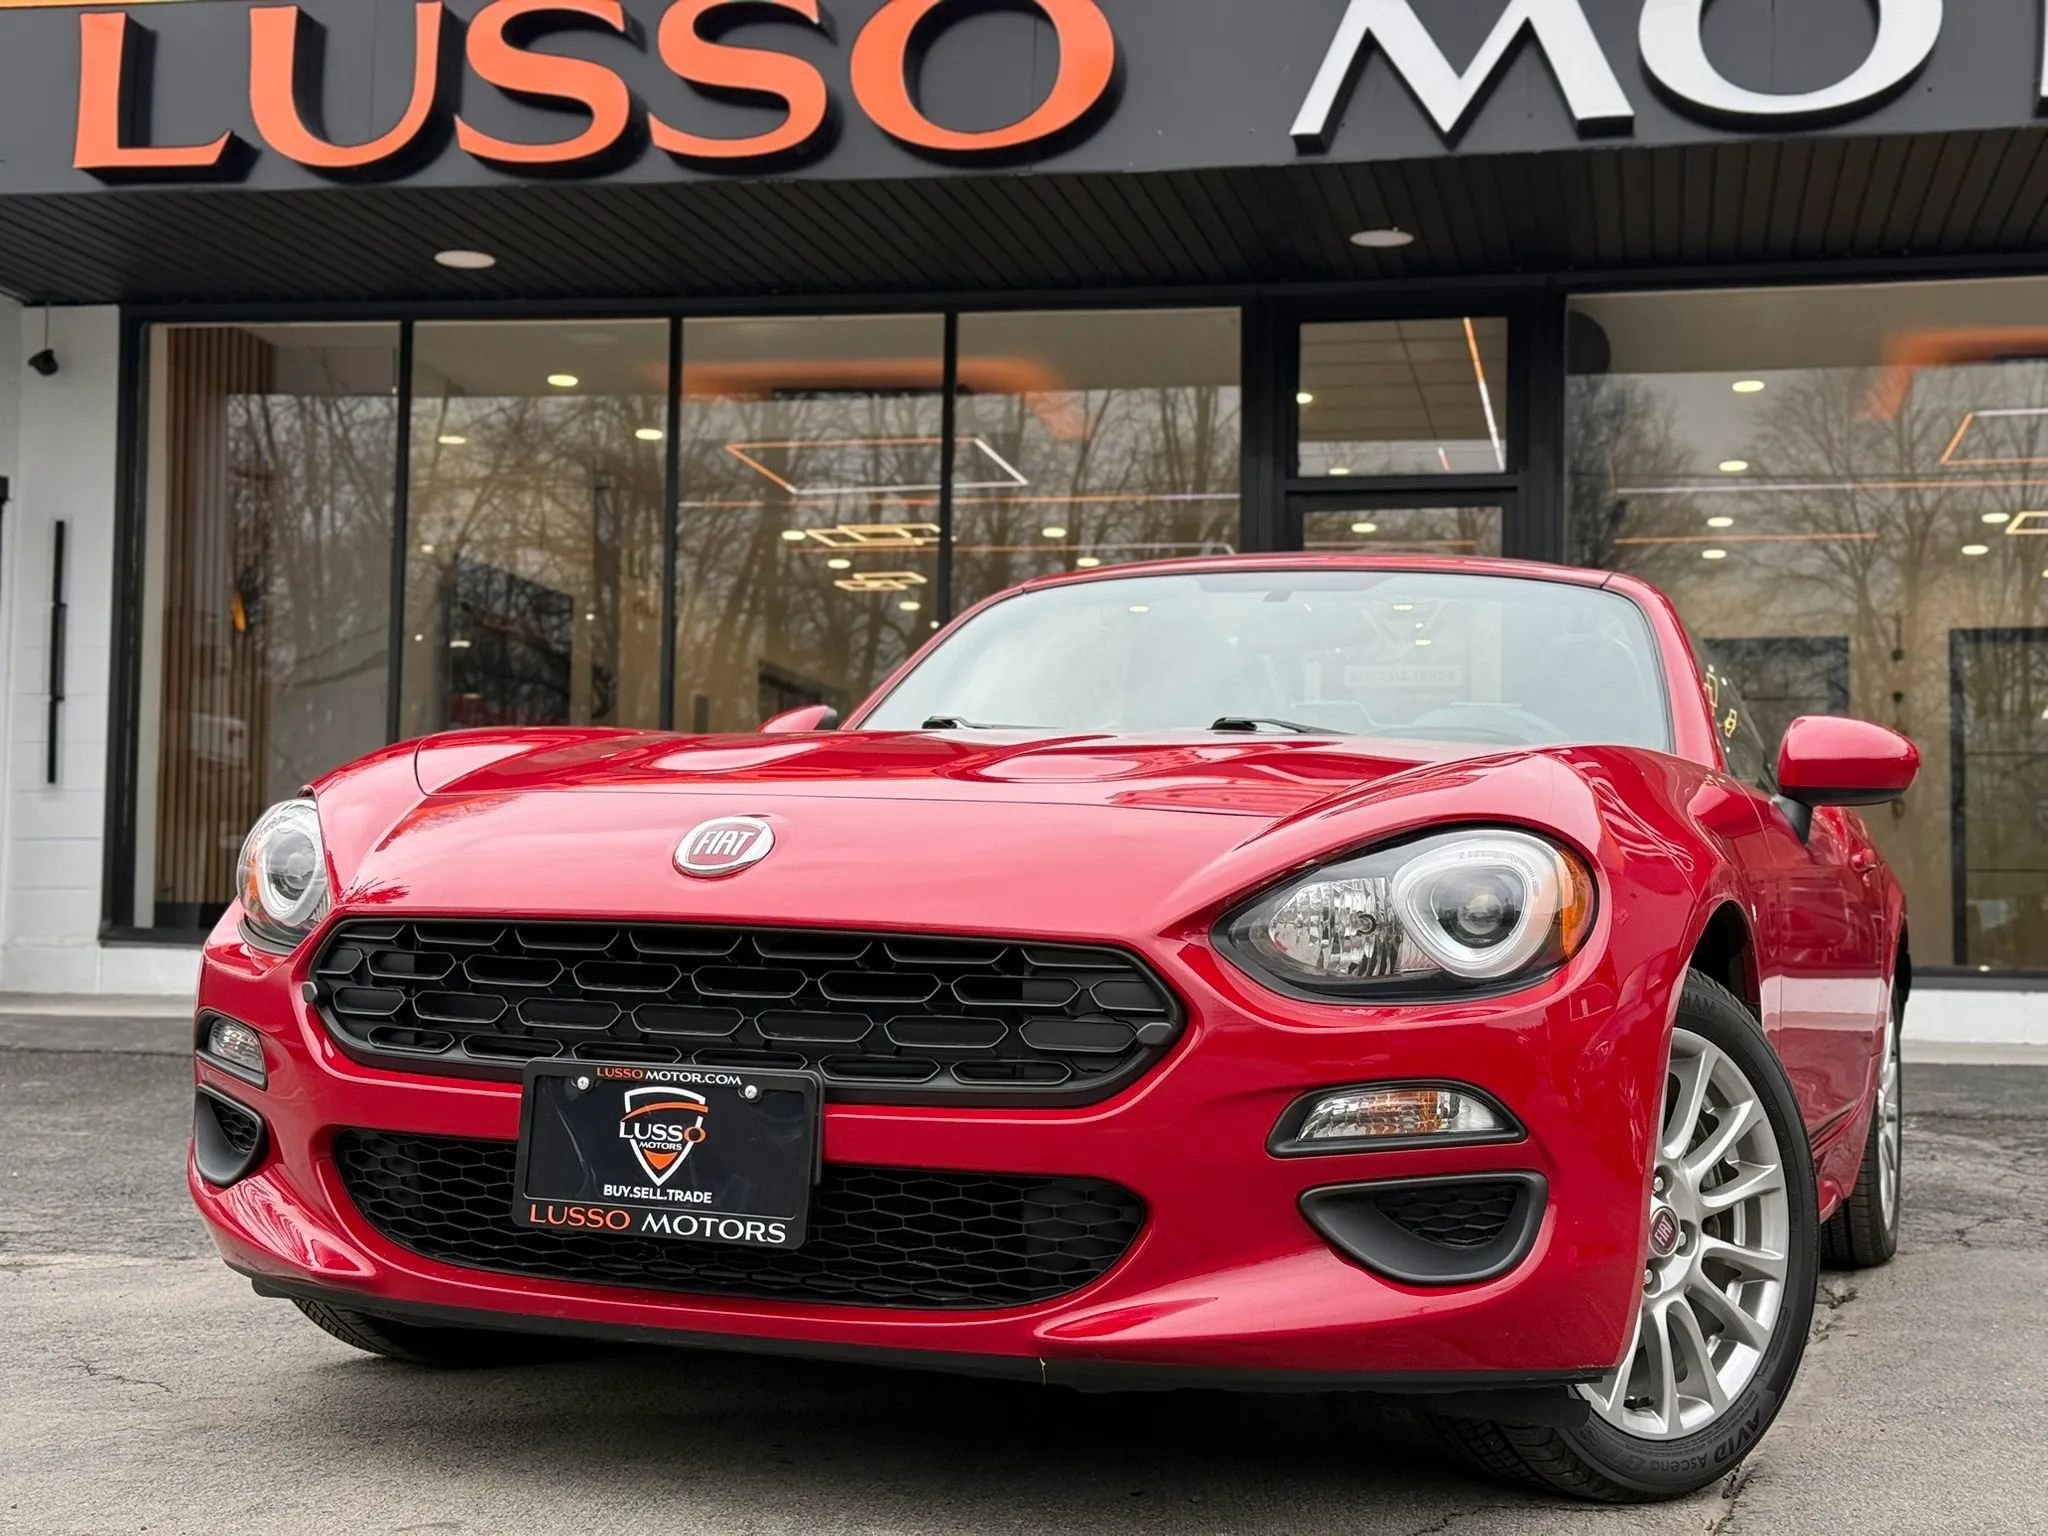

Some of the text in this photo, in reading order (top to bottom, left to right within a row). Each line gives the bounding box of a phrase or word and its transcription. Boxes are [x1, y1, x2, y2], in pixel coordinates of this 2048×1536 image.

[73, 0, 2048, 169] LUSSO MO
[692, 830, 757, 856] FIAT
[596, 1066, 742, 1086] LUSSOMOTOR.COM
[619, 1121, 707, 1144] LUSSO
[638, 1141, 683, 1151] MOTORS
[603, 1184, 713, 1204] BUY.SELL.TRADE
[529, 1203, 787, 1244] LUSSO MOTORS
[1653, 1215, 1673, 1247] FIAT
[1713, 1407, 1762, 1465] AVID
[1649, 1456, 1708, 1474] Ascend
